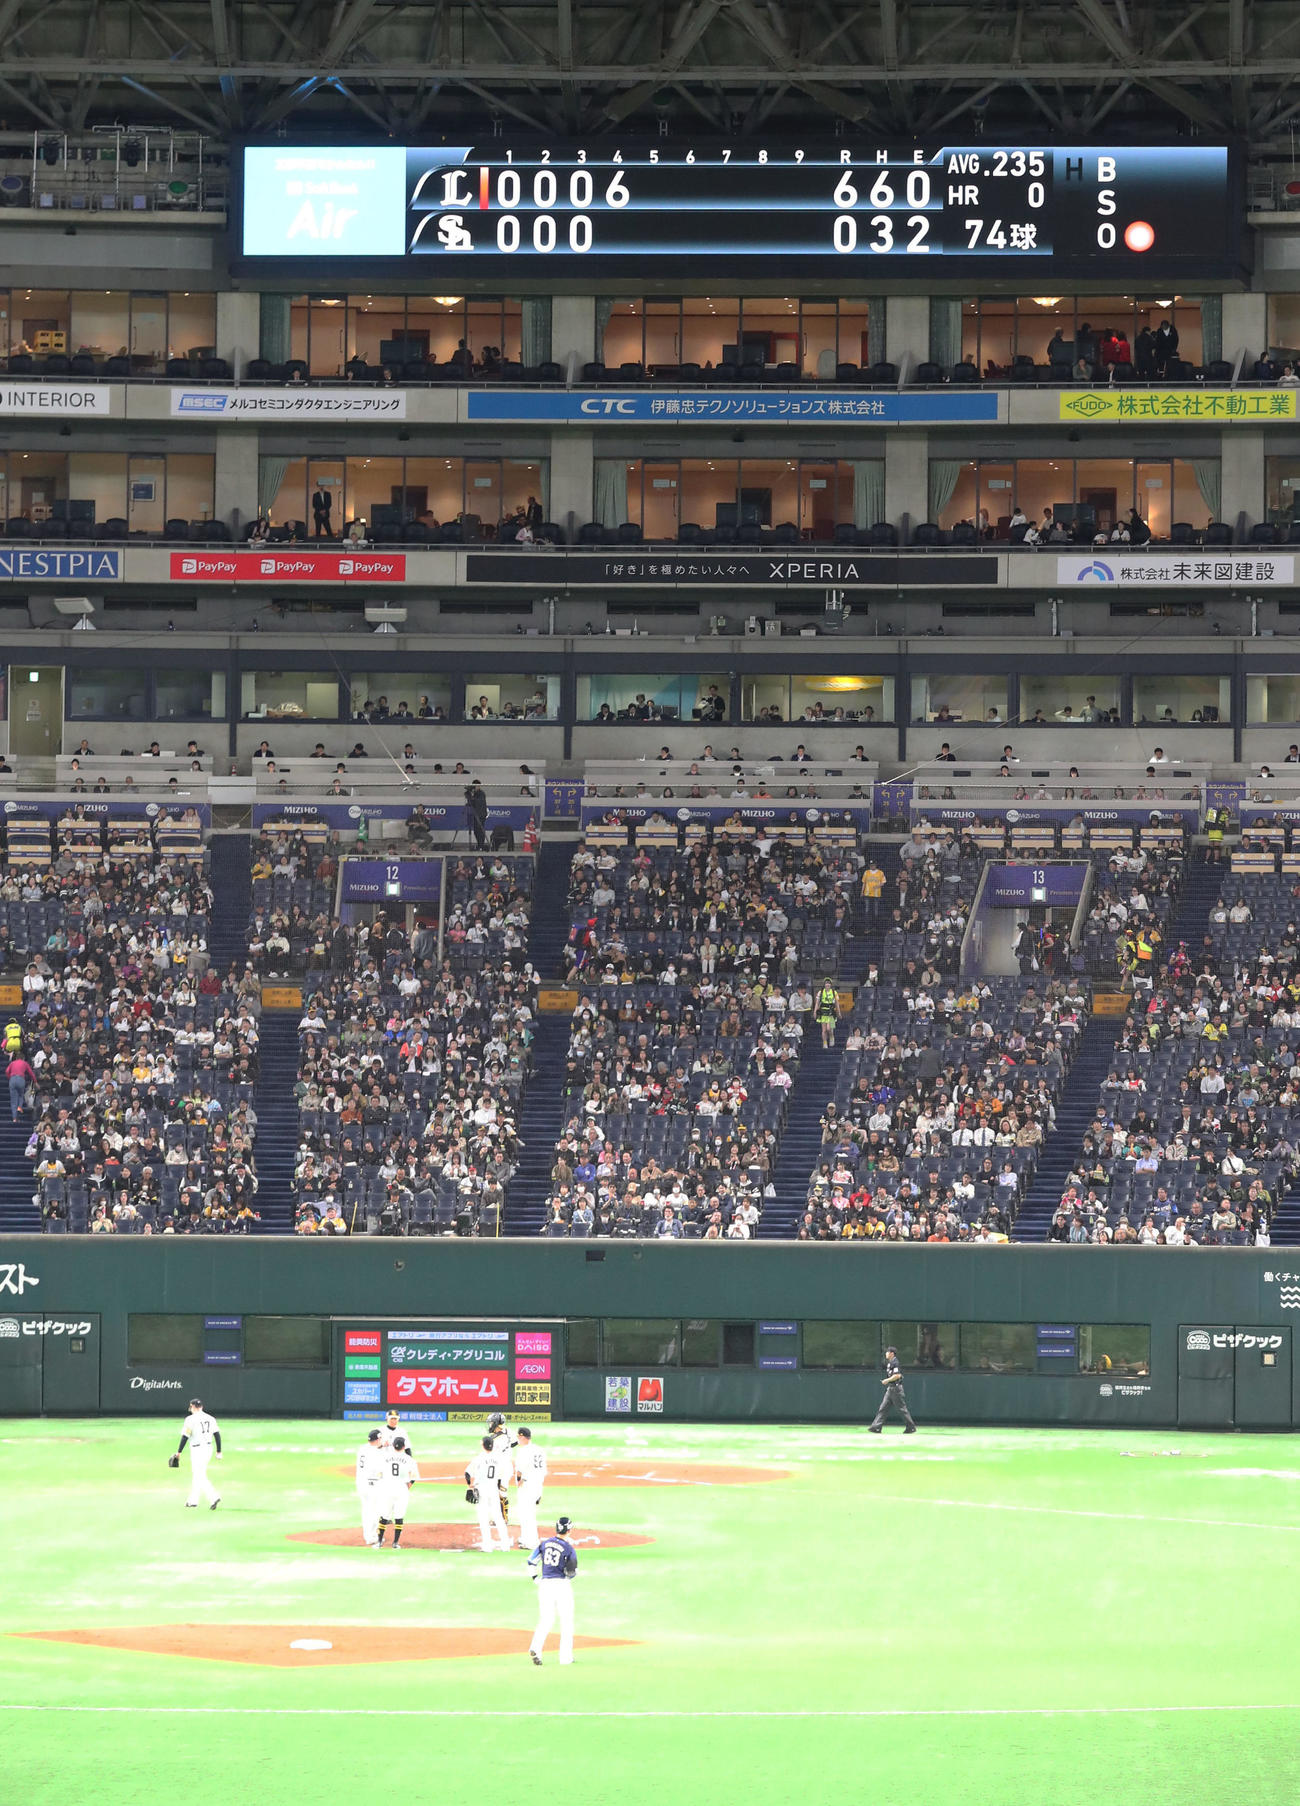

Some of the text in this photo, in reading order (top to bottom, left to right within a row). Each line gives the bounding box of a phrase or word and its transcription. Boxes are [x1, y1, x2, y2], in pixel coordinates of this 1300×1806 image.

[505, 149, 924, 165] 1 2 3 4 5 6 7 8 9 R H E
[947, 150, 1045, 177] AVG .235
[1065, 157, 1083, 181] H
[1097, 156, 1117, 183] B
[497, 171, 521, 207] 0
[533, 171, 557, 207] 0
[570, 171, 593, 207] 0
[605, 171, 630, 207] 6
[833, 171, 858, 207] 6
[870, 171, 894, 207] 6
[907, 171, 930, 207] 0
[948, 182, 1045, 207] HR 0
[1097, 189, 1117, 216] S
[286, 199, 359, 239] Air
[497, 214, 520, 253] 0
[533, 214, 556, 253] 0
[569, 214, 592, 253] 0
[833, 214, 857, 253] 0
[870, 214, 894, 253] 3
[907, 214, 930, 253] 2
[965, 219, 1037, 251] 74球
[8, 392, 96, 408] INTERIOR
[229, 398, 401, 411] メルコセミコンダクタエンジニアリング
[580, 399, 886, 416] CTC 伊藤忠テクノソリューションズ株式会社
[1116, 395, 1290, 416] 株式会社不動工業
[0, 553, 116, 576] NESTPIA
[197, 560, 394, 576] PayPay PayPay PayPay
[603, 562, 860, 579] 「好き」を極めたい人々へ XPERIA
[17, 804, 39, 812] MIZUHO
[283, 805, 318, 814] MIZUHO
[361, 808, 383, 816] MIZUHO
[412, 807, 446, 816] MZUHO
[488, 808, 511, 817] MIZUHO
[612, 808, 646, 817] MZUHO
[741, 809, 775, 818] MIZUHO
[941, 811, 975, 819] MIZUHO
[1084, 811, 1118, 820] MIZUHO
[385, 866, 399, 880] 12
[1032, 870, 1045, 884] 13
[349, 883, 380, 892] MIZUHO
[995, 888, 1025, 896] MIZUHO
[22, 1320, 92, 1335] ピザクック
[1212, 1333, 1283, 1349] ピザクック
[406, 1348, 505, 1361] クレディ・アグリコル
[396, 1376, 499, 1398] タマホーム
[638, 1402, 663, 1411] マルハン
[200, 1421, 210, 1434] 17
[391, 1462, 400, 1477] 8
[487, 1465, 495, 1479] 0
[543, 1547, 562, 1567] 63
